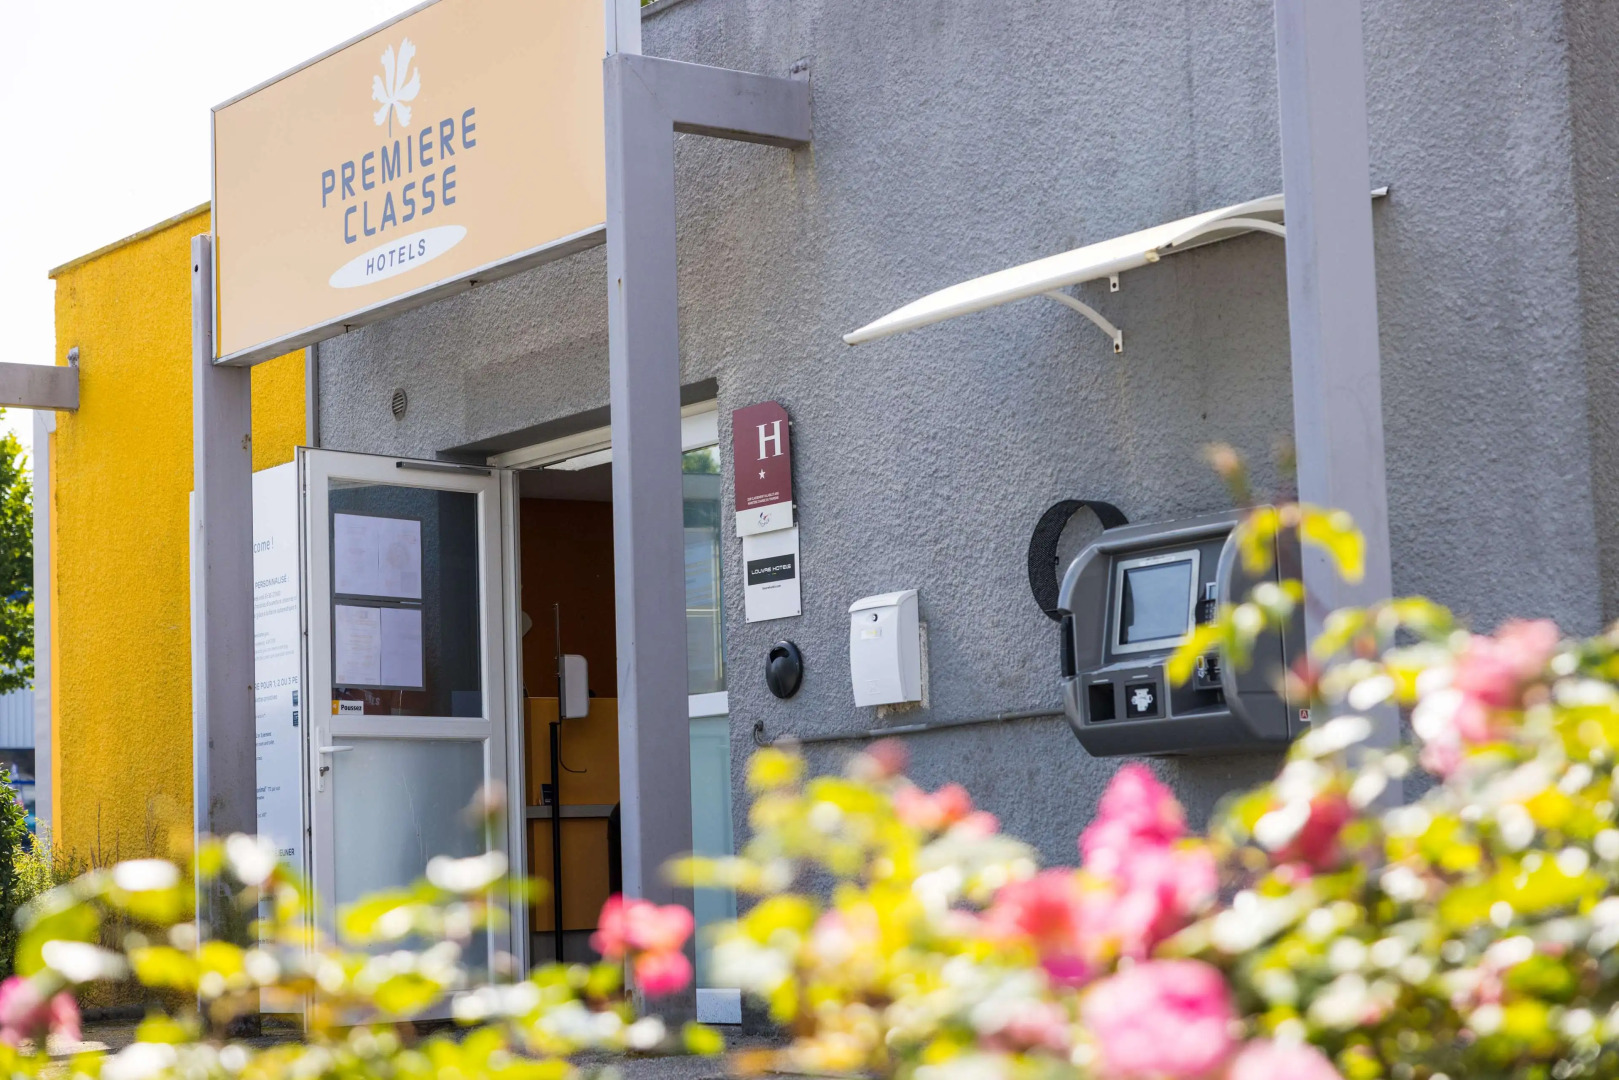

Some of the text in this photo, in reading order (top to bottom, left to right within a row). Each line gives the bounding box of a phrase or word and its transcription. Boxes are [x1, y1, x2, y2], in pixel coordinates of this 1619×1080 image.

[322, 107, 476, 208] PREMIERE
[344, 165, 456, 244] CLASSE
[366, 238, 426, 276] HOTELS
[756, 420, 784, 460] H
[751, 566, 771, 575] LOUVRE
[773, 563, 792, 571] HOTELS
